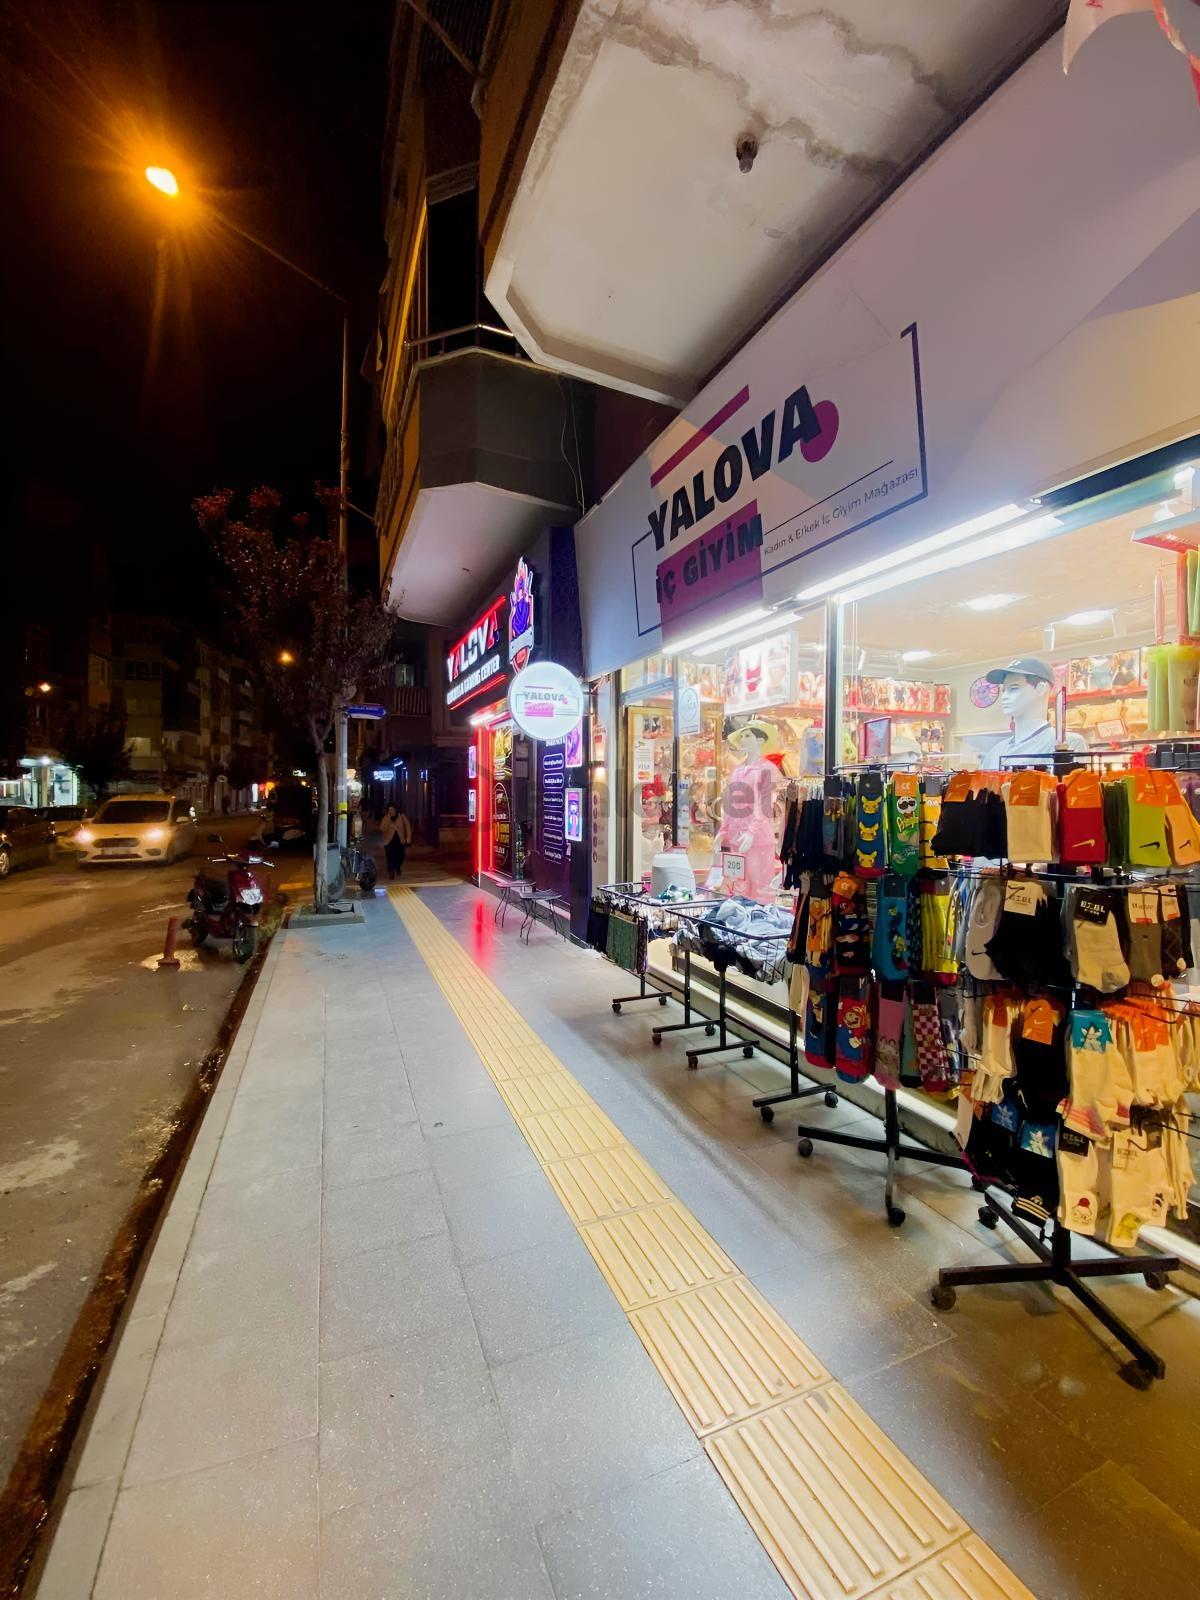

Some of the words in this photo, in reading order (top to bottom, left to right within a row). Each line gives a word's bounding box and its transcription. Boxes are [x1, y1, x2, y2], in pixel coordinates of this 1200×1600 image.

[648, 385, 821, 551] YALOVA
[764, 539, 786, 556] Kadın
[787, 535, 794, 544] &
[795, 519, 820, 539] Erkek
[832, 498, 861, 519] Giyim
[864, 467, 918, 502] Mağazası
[656, 568, 676, 604] İÇ
[683, 513, 763, 587] GİYİM
[523, 691, 565, 701] YALOVA
